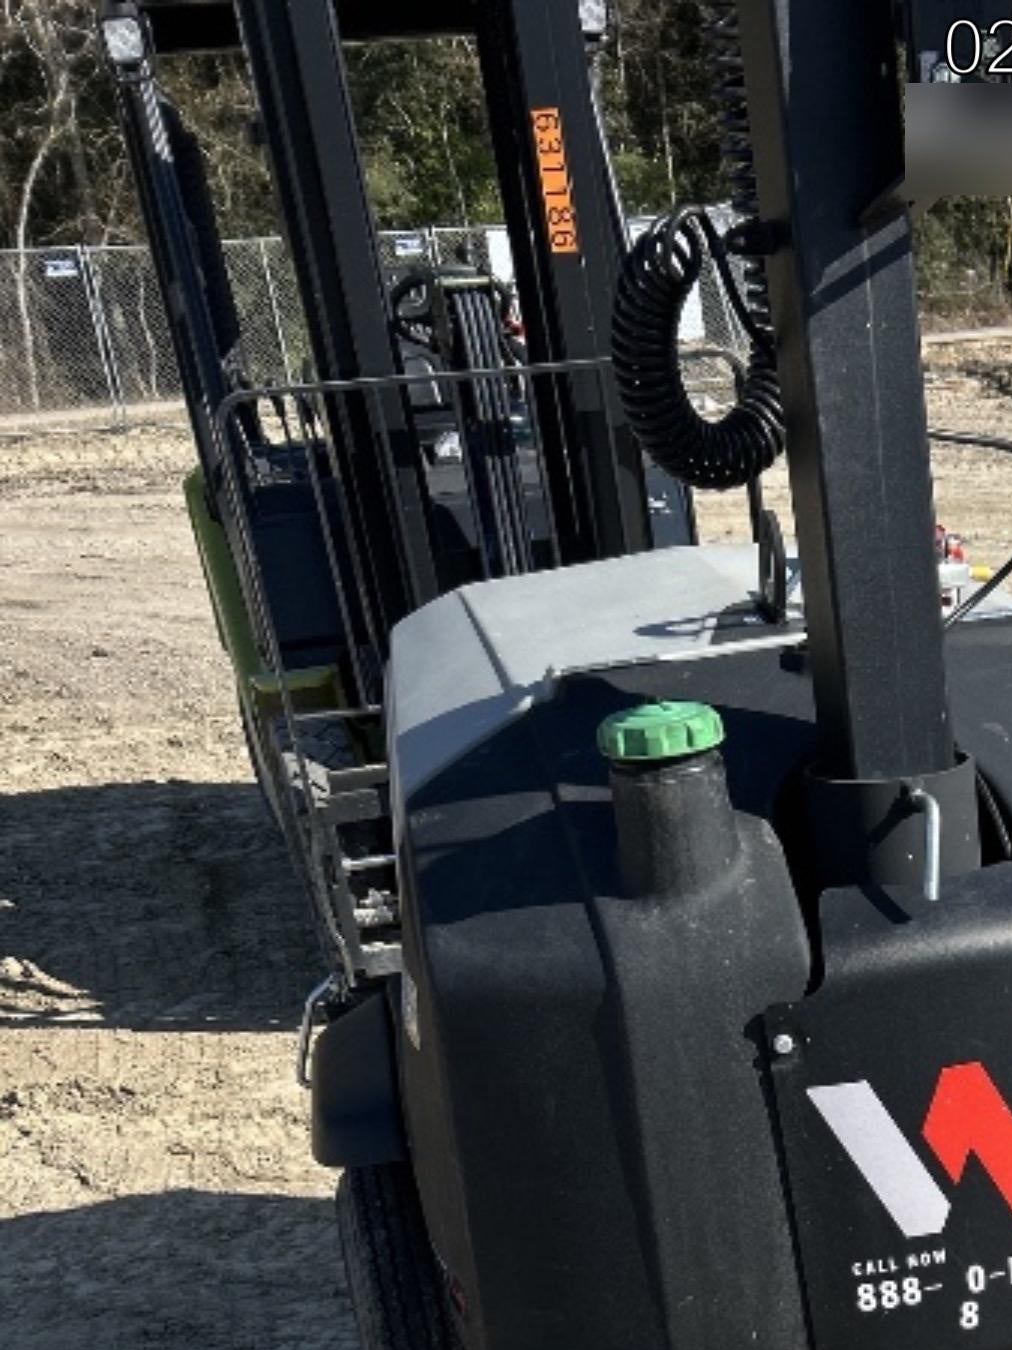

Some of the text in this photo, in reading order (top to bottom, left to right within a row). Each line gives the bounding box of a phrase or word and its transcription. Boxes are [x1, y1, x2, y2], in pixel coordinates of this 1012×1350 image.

[535, 113, 576, 247] 631186
[852, 1248, 946, 1276] CALL NOW
